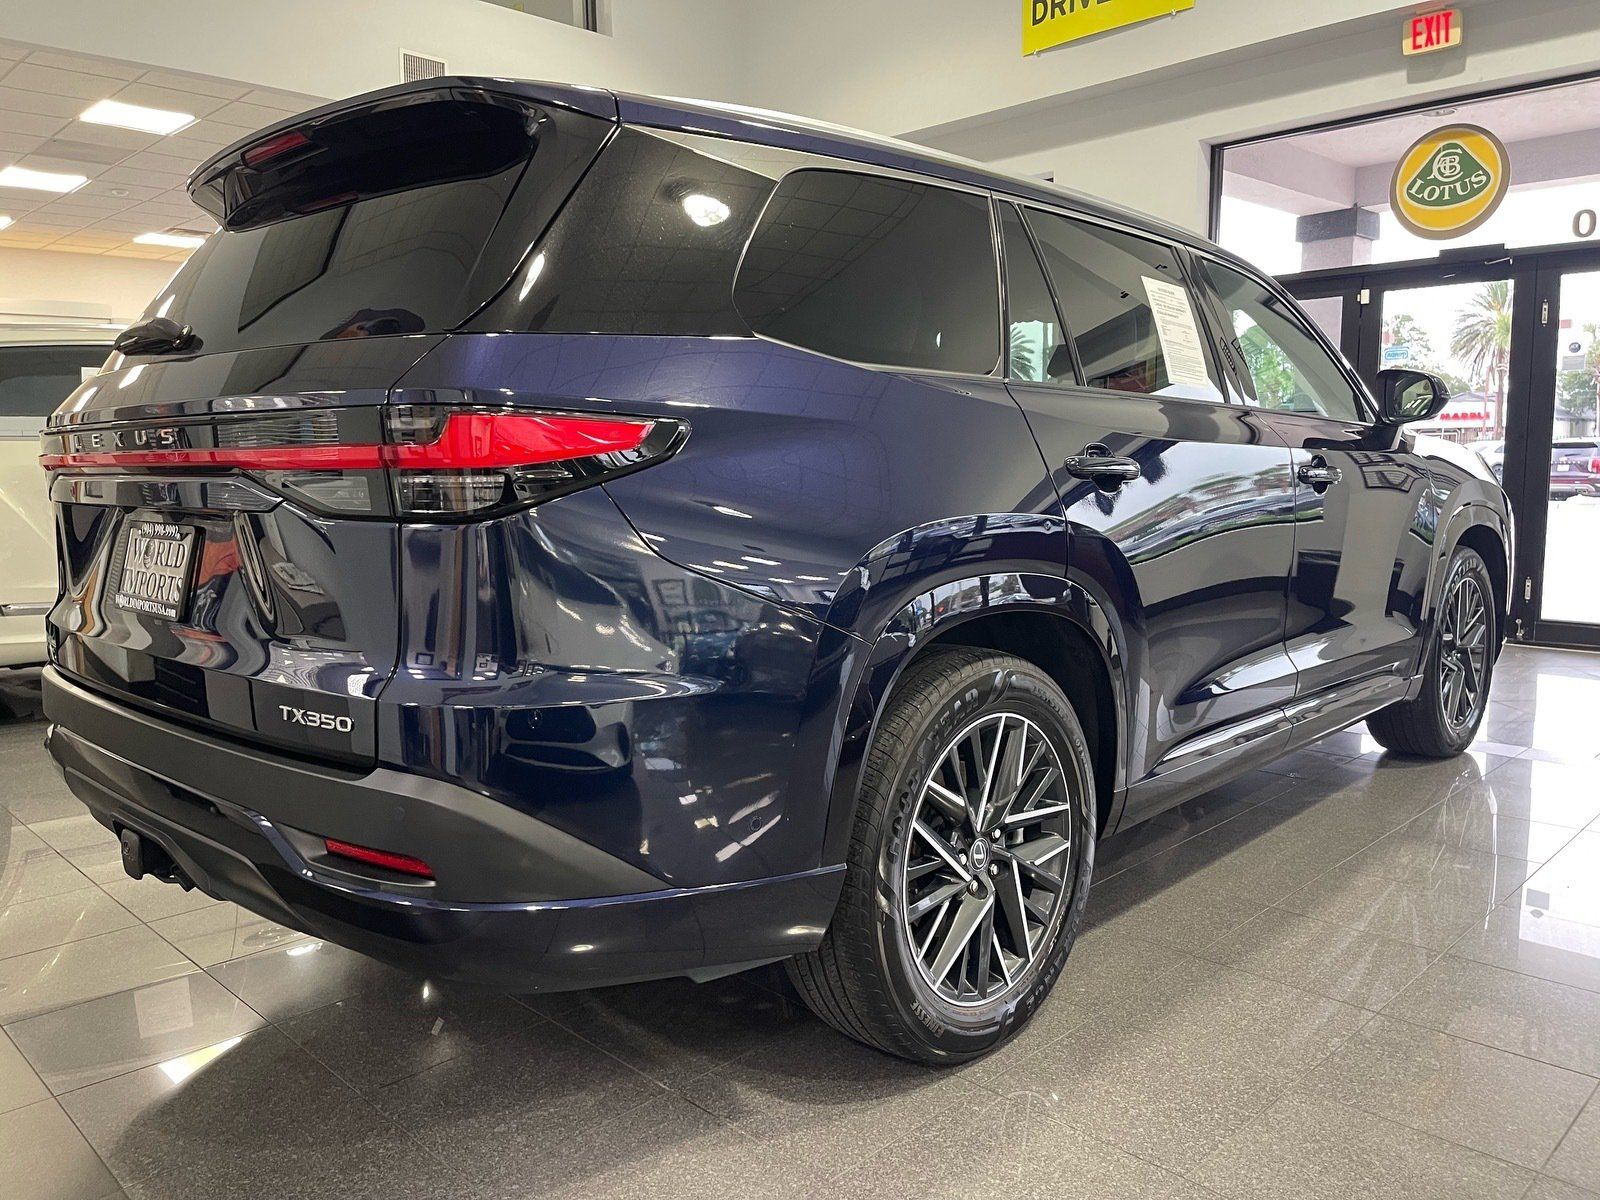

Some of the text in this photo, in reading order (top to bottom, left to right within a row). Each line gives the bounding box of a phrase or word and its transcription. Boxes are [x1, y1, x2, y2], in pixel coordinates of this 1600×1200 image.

[1412, 12, 1453, 50] EXIT
[1409, 170, 1488, 201] LOTUS
[74, 428, 174, 449] LEXUS
[134, 538, 187, 569] WORLD
[120, 568, 184, 603] IMPORTS
[115, 593, 177, 618] WRLDIMPORTSUSA.com
[279, 705, 352, 732] TX350
